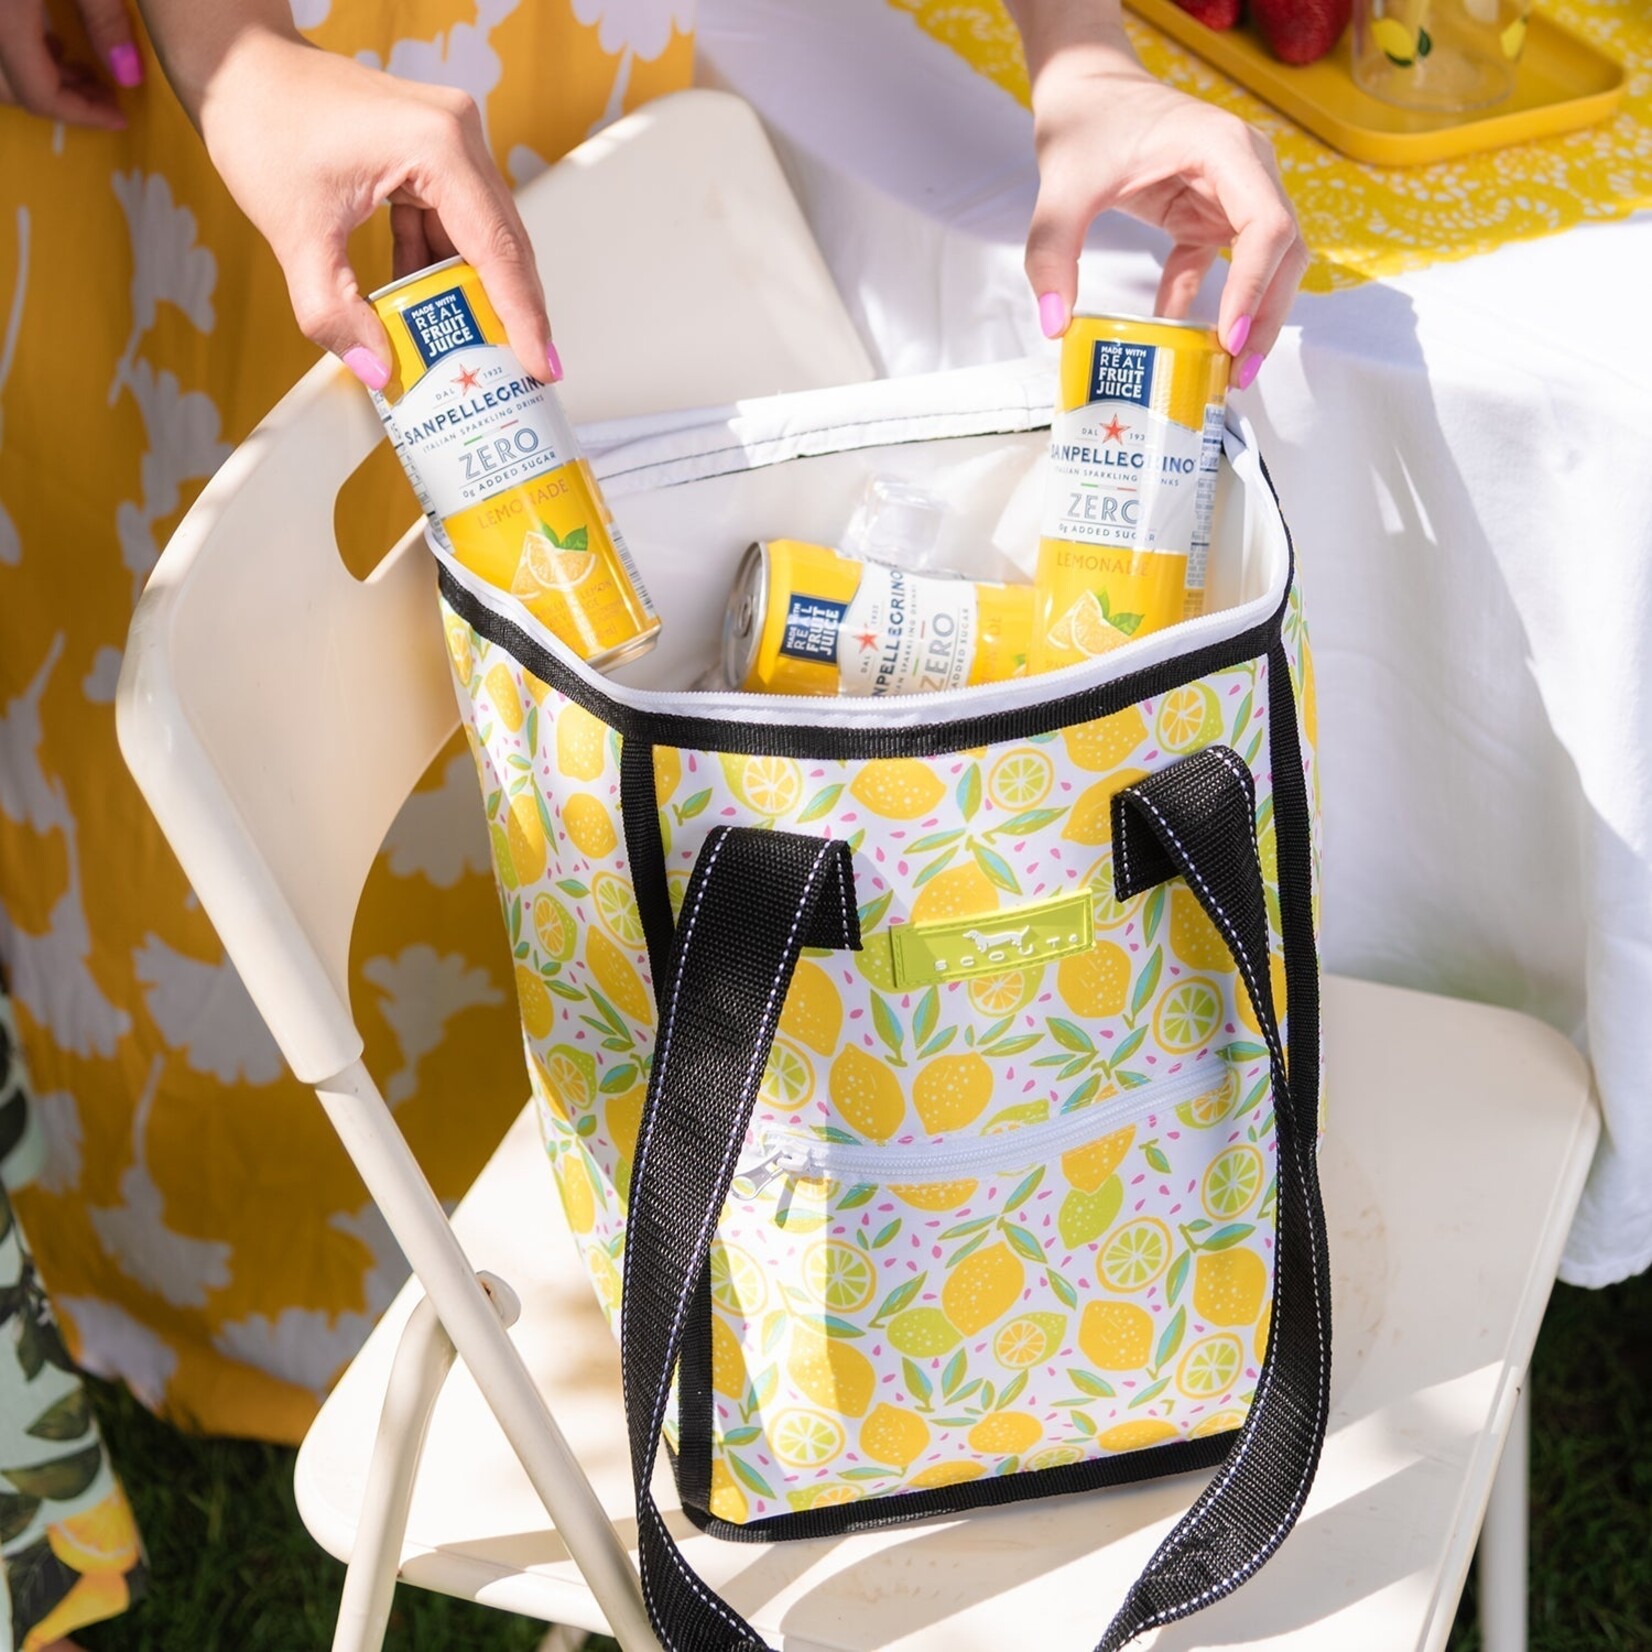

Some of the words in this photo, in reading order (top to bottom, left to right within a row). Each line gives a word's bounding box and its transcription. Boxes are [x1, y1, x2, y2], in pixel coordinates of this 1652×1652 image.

[411, 304, 434, 320] MADE
[435, 294, 457, 309] WITH
[415, 303, 462, 329] REAL
[420, 314, 468, 344] FRUIT
[428, 327, 474, 357] JUICE
[1100, 346, 1122, 356] MADE
[1125, 347, 1147, 358] WITH
[1100, 355, 1145, 369] REAL
[435, 387, 455, 401] DAL
[482, 367, 503, 380] 1932
[1096, 382, 1142, 398] JUICE
[1098, 367, 1145, 384] FRUIT
[404, 374, 546, 446] SANPELLEGRIN
[422, 434, 457, 453] ITALIAN
[460, 407, 513, 436] SPARKLING
[1081, 427, 1098, 436] DAL
[1129, 432, 1146, 442] 193
[459, 427, 540, 480] ZERO
[1050, 444, 1195, 474] ANPELLEGINO
[478, 467, 519, 491] ADDED
[521, 451, 557, 475] SUGAR
[1083, 469, 1138, 482] SPARKLING
[1071, 525, 1110, 538] ADDED
[786, 626, 797, 649] MADE
[794, 605, 813, 650] REAL
[806, 606, 826, 653] FRUIT
[820, 609, 840, 656] JUICE
[871, 569, 905, 697] NPELLEGRINO
[901, 619, 916, 673] SPARKLING
[920, 612, 955, 691] ZERO
[951, 649, 966, 689] ADDED
[961, 608, 969, 645] SUGAR
[860, 655, 871, 673] DAL
